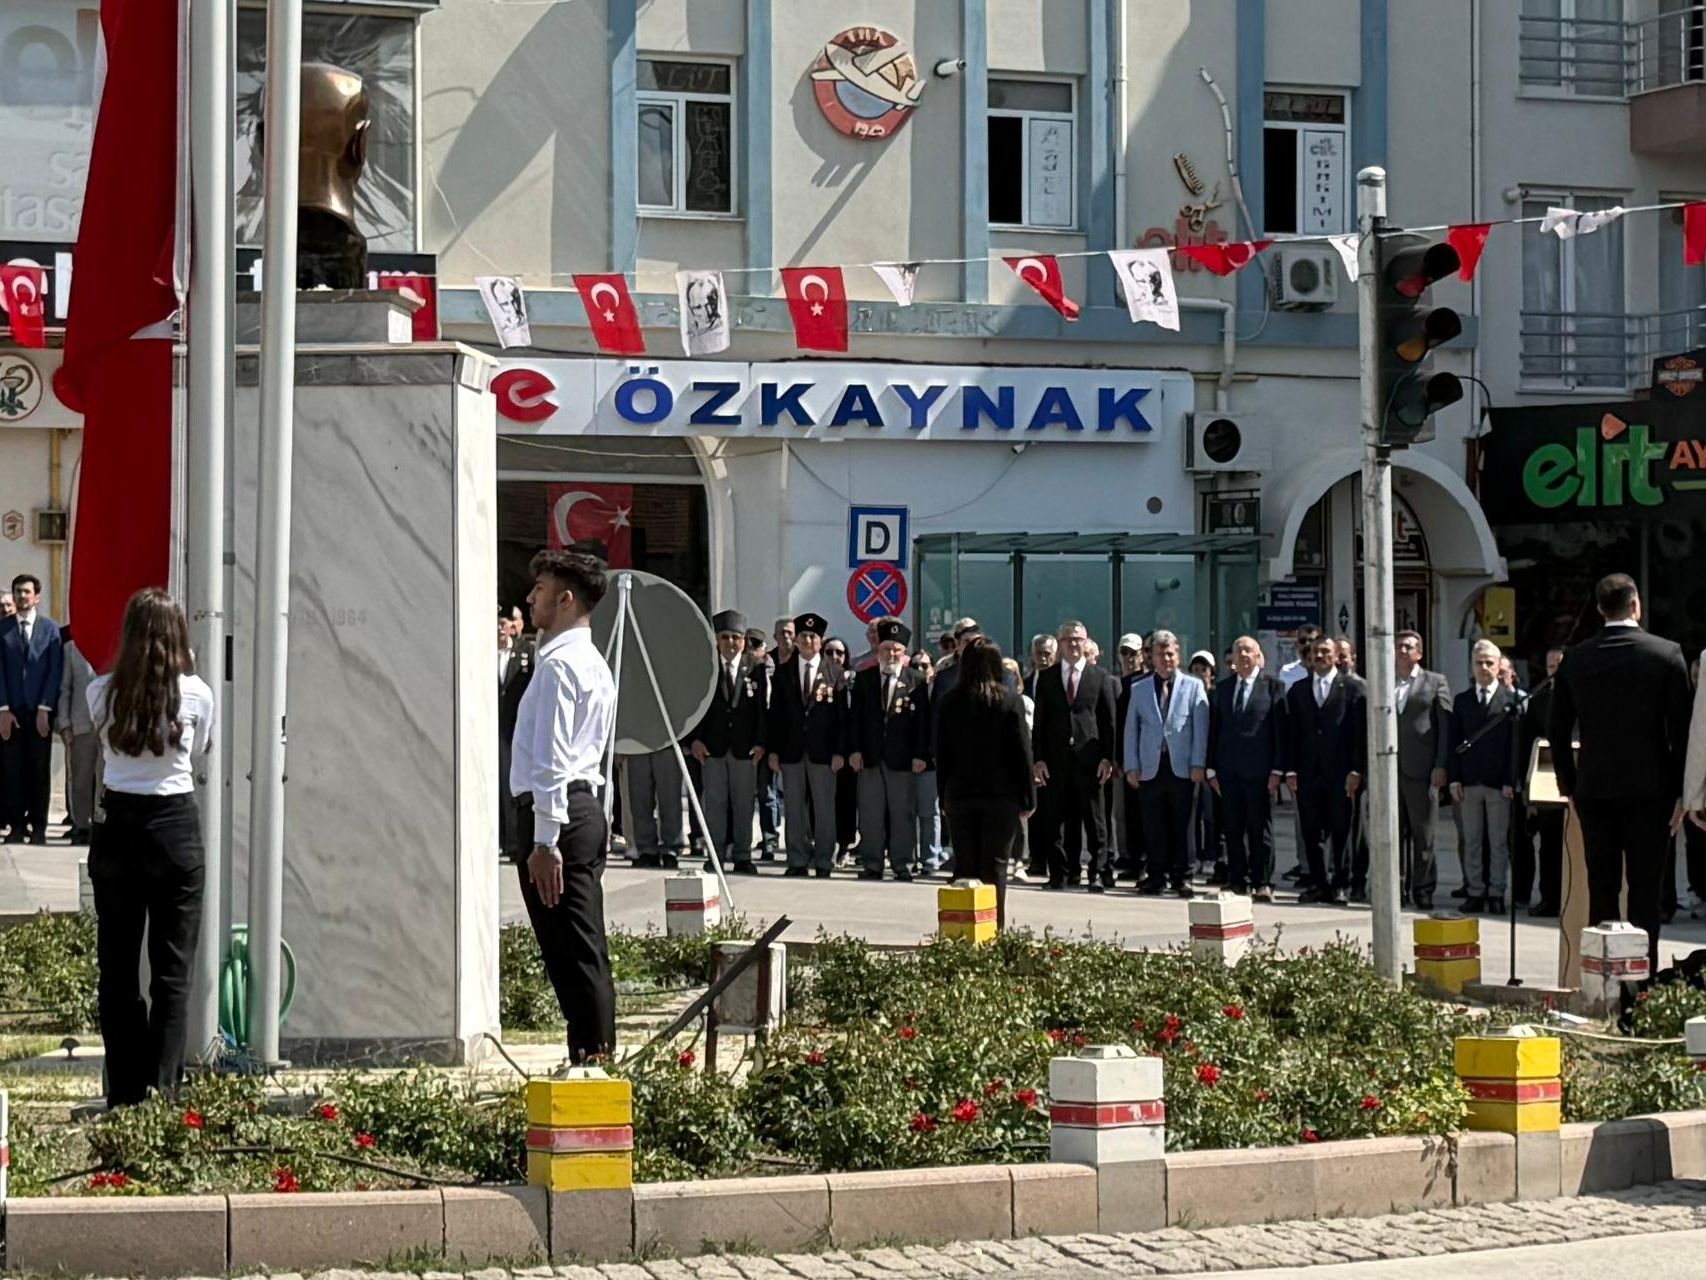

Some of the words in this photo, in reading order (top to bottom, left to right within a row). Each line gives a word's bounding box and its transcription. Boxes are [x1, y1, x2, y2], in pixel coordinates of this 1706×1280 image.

[613, 365, 1154, 435] ÖZKAYNAK
[1523, 413, 1669, 508] elit
[864, 520, 891, 555] D
